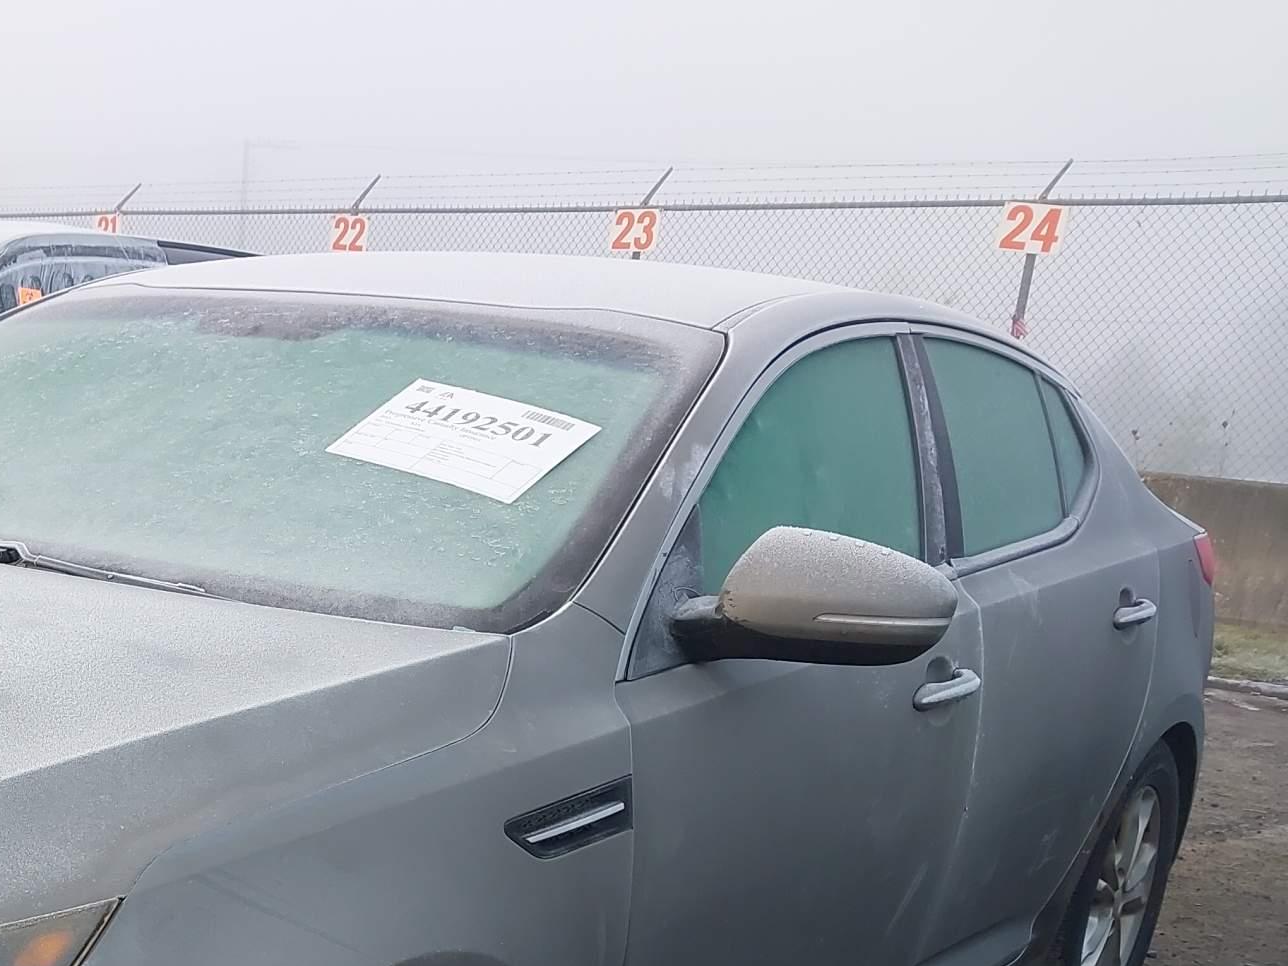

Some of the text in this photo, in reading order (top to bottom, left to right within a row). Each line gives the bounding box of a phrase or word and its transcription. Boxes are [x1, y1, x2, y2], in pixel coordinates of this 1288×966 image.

[332, 216, 365, 251] 22
[612, 210, 656, 250] 23
[999, 204, 1062, 252] 24
[405, 400, 553, 448] 44192501
